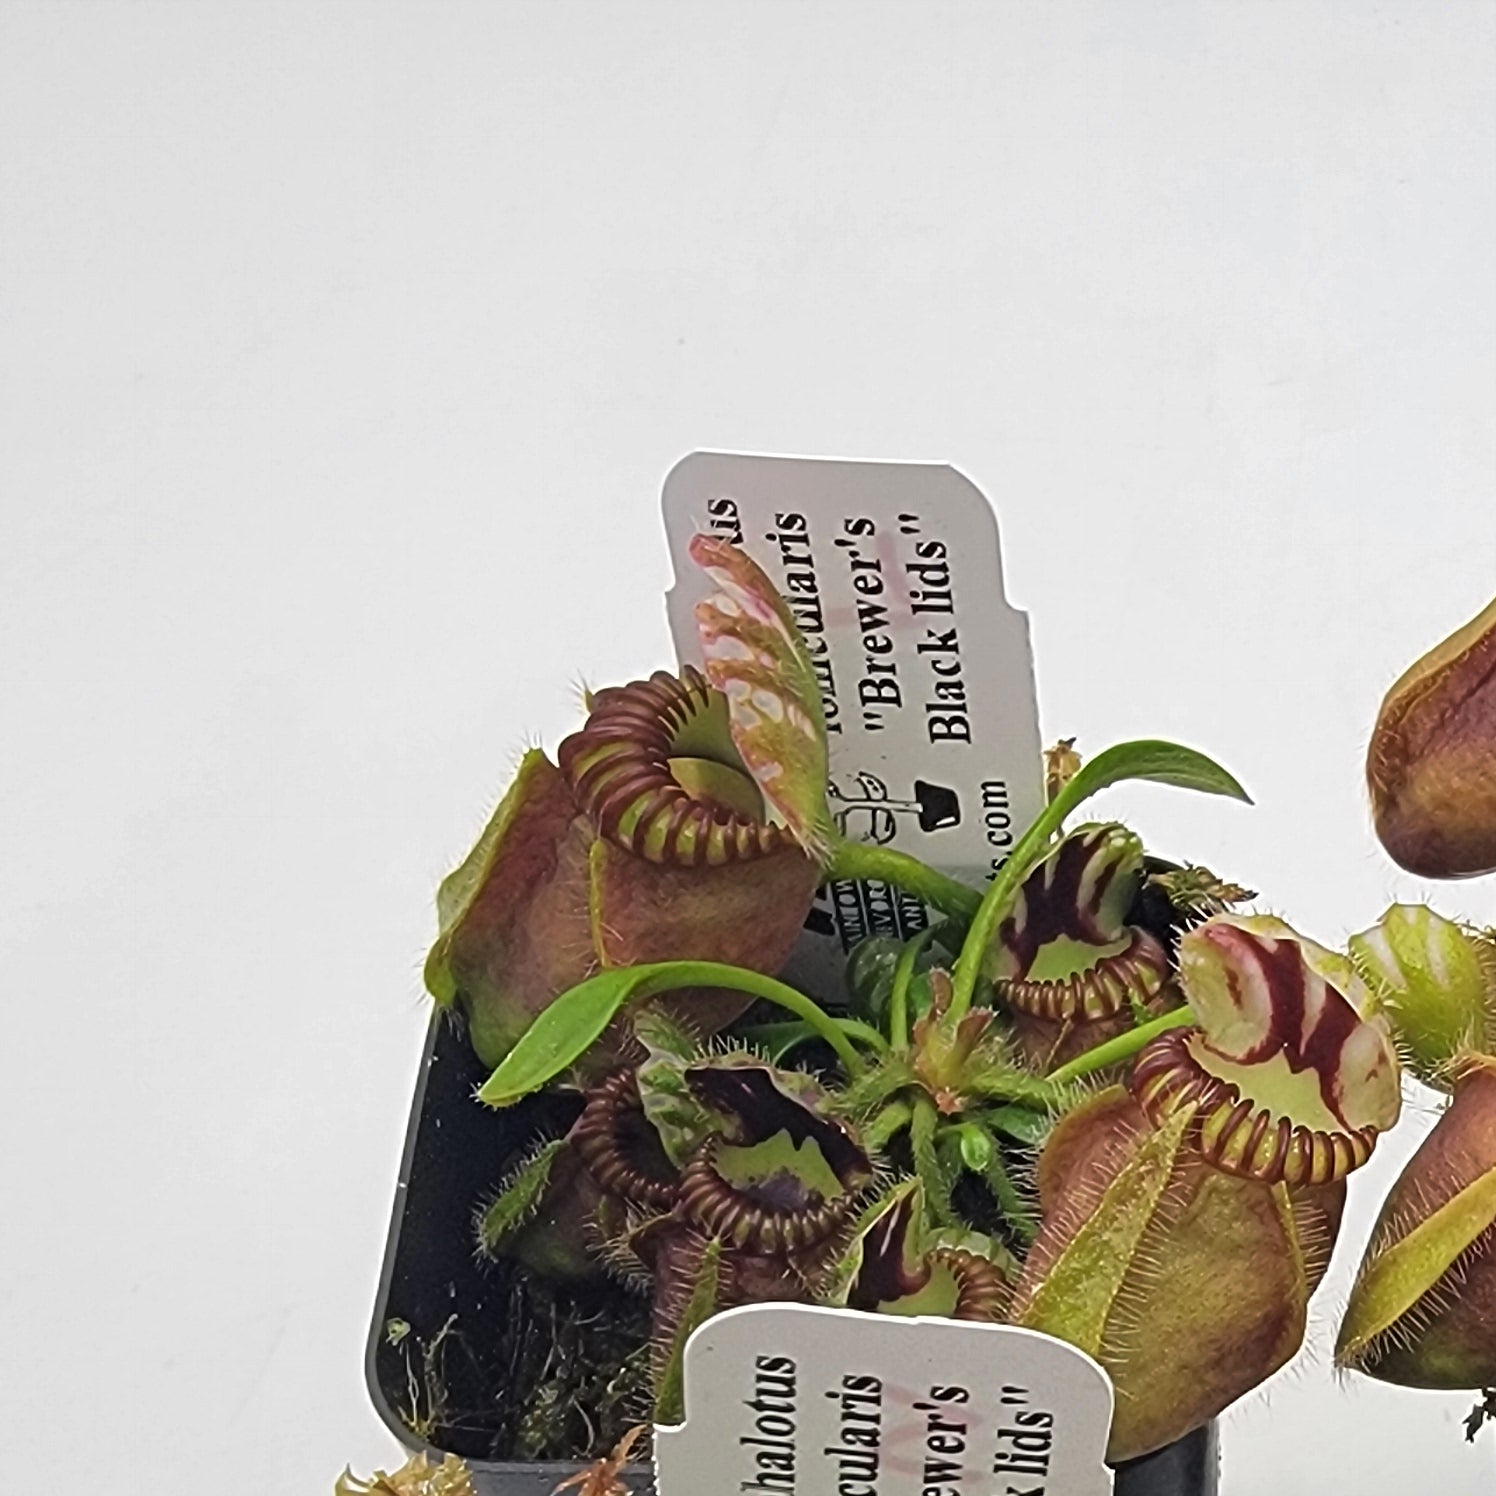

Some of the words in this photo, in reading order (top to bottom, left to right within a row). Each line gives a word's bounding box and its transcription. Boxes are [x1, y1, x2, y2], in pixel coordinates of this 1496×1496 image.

[897, 513, 955, 616] lids"
[834, 517, 902, 732] "Brewer's
[916, 628, 972, 745] Black
[992, 1386, 1054, 1477] lids"
